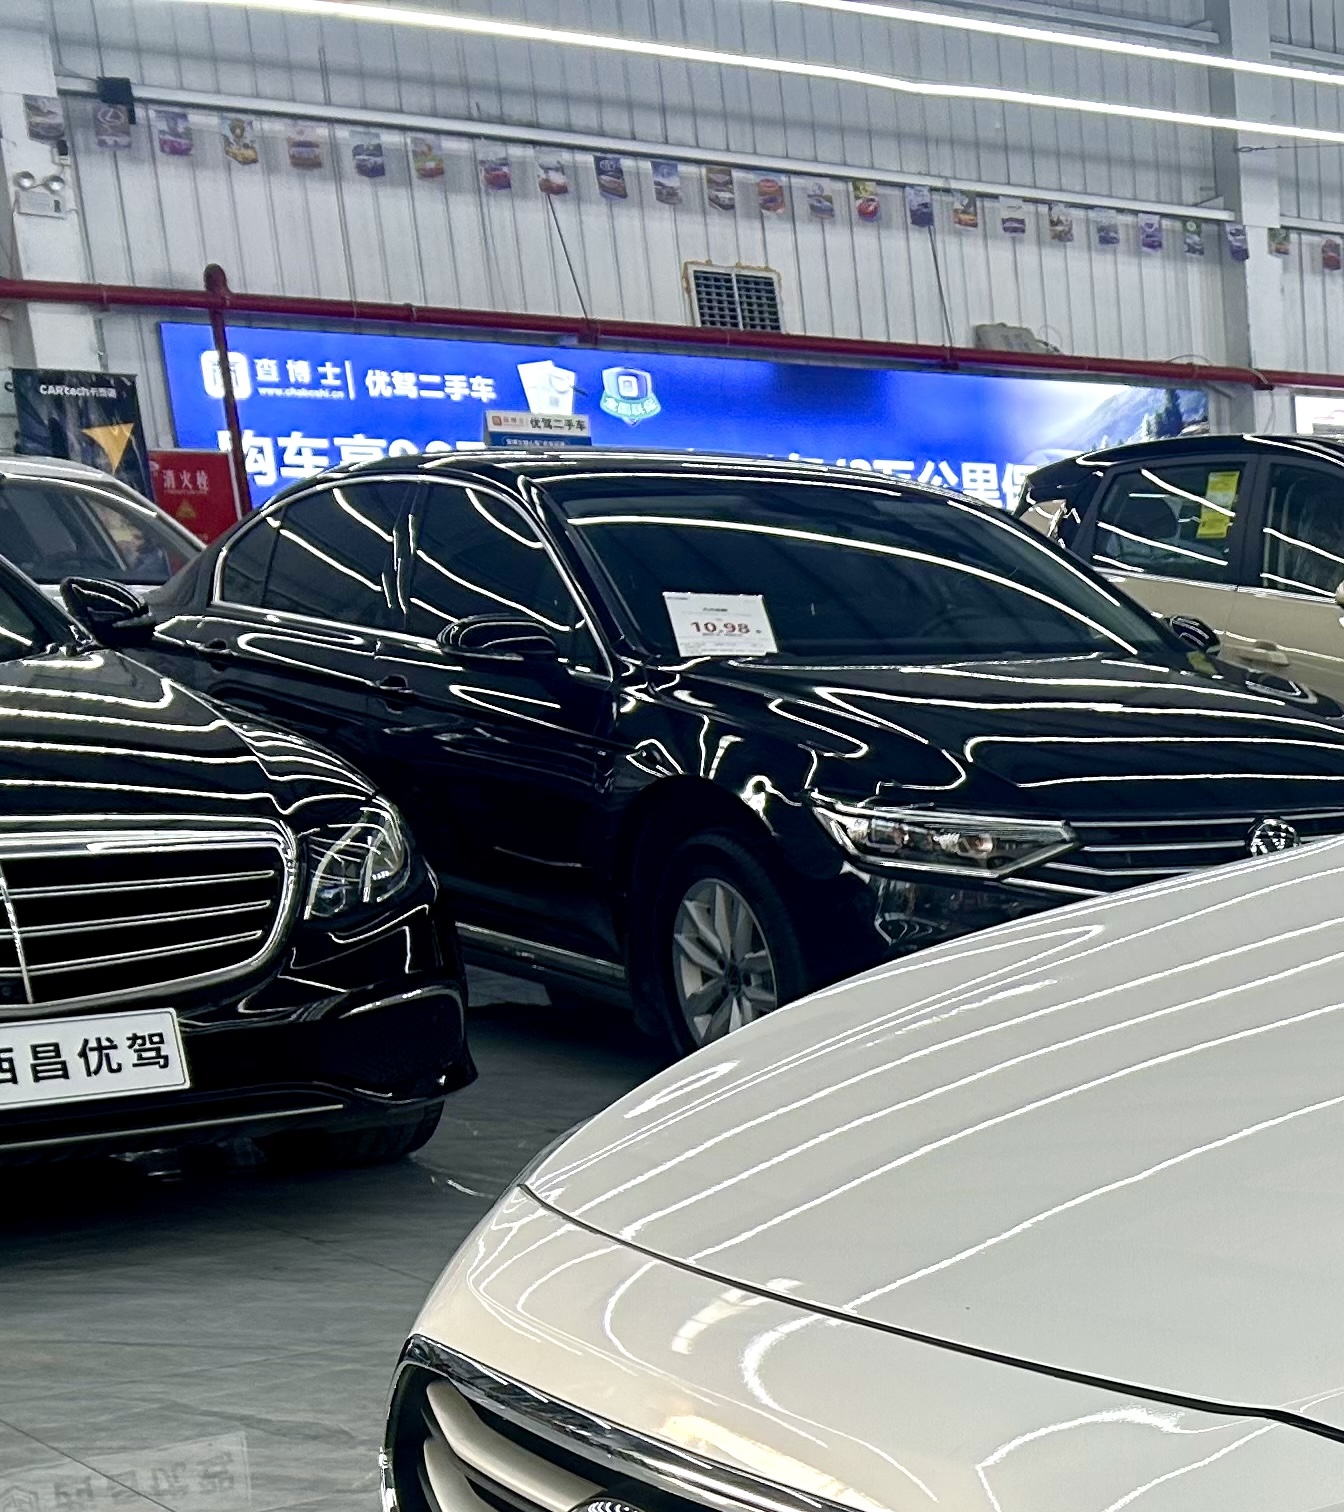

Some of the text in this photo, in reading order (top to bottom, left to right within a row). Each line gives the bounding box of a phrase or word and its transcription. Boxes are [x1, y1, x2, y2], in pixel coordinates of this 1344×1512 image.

[365, 369, 497, 402] 优驾二手车
[691, 621, 750, 634] 10.98
